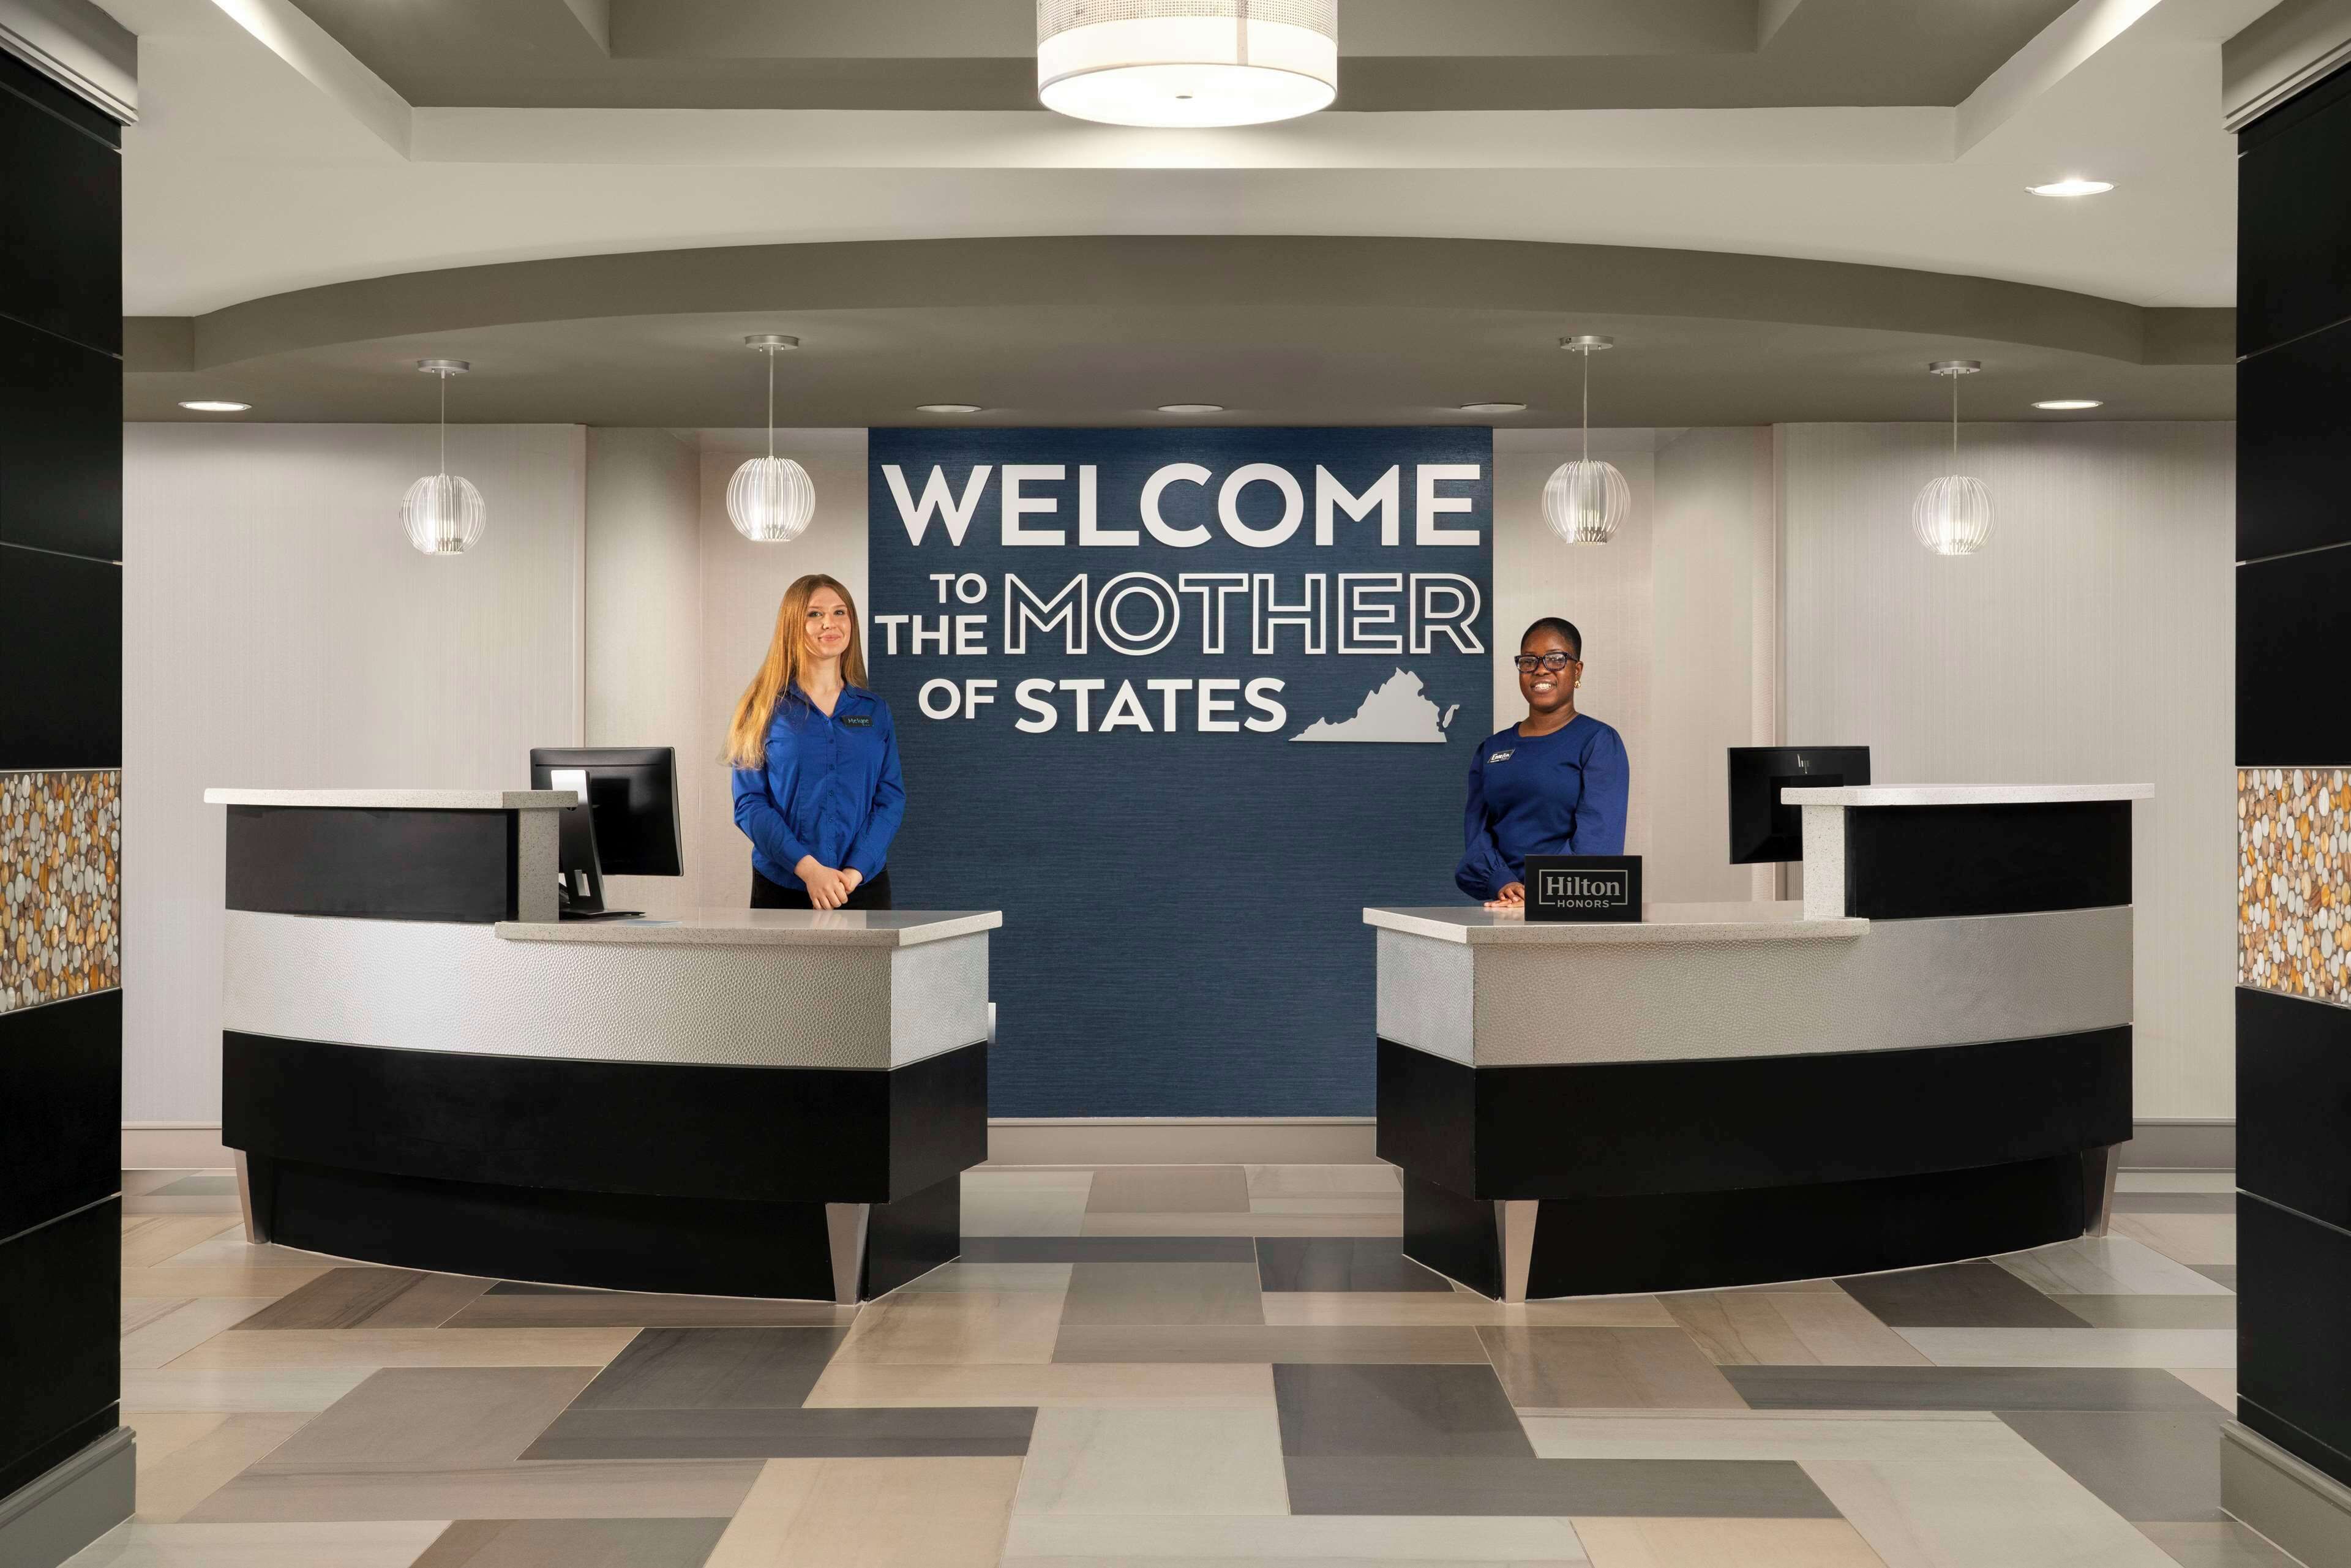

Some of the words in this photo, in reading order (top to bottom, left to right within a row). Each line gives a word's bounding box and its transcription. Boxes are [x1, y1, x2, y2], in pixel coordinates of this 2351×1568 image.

[882, 463, 1480, 547] WELCOME
[930, 573, 986, 603] TO
[875, 615, 987, 655] THE
[1005, 572, 1484, 655] MOTHER
[919, 679, 997, 719] OF
[1015, 678, 1286, 733] STATES
[1546, 876, 1620, 896] Hilton
[1557, 899, 1610, 908] HONORS
